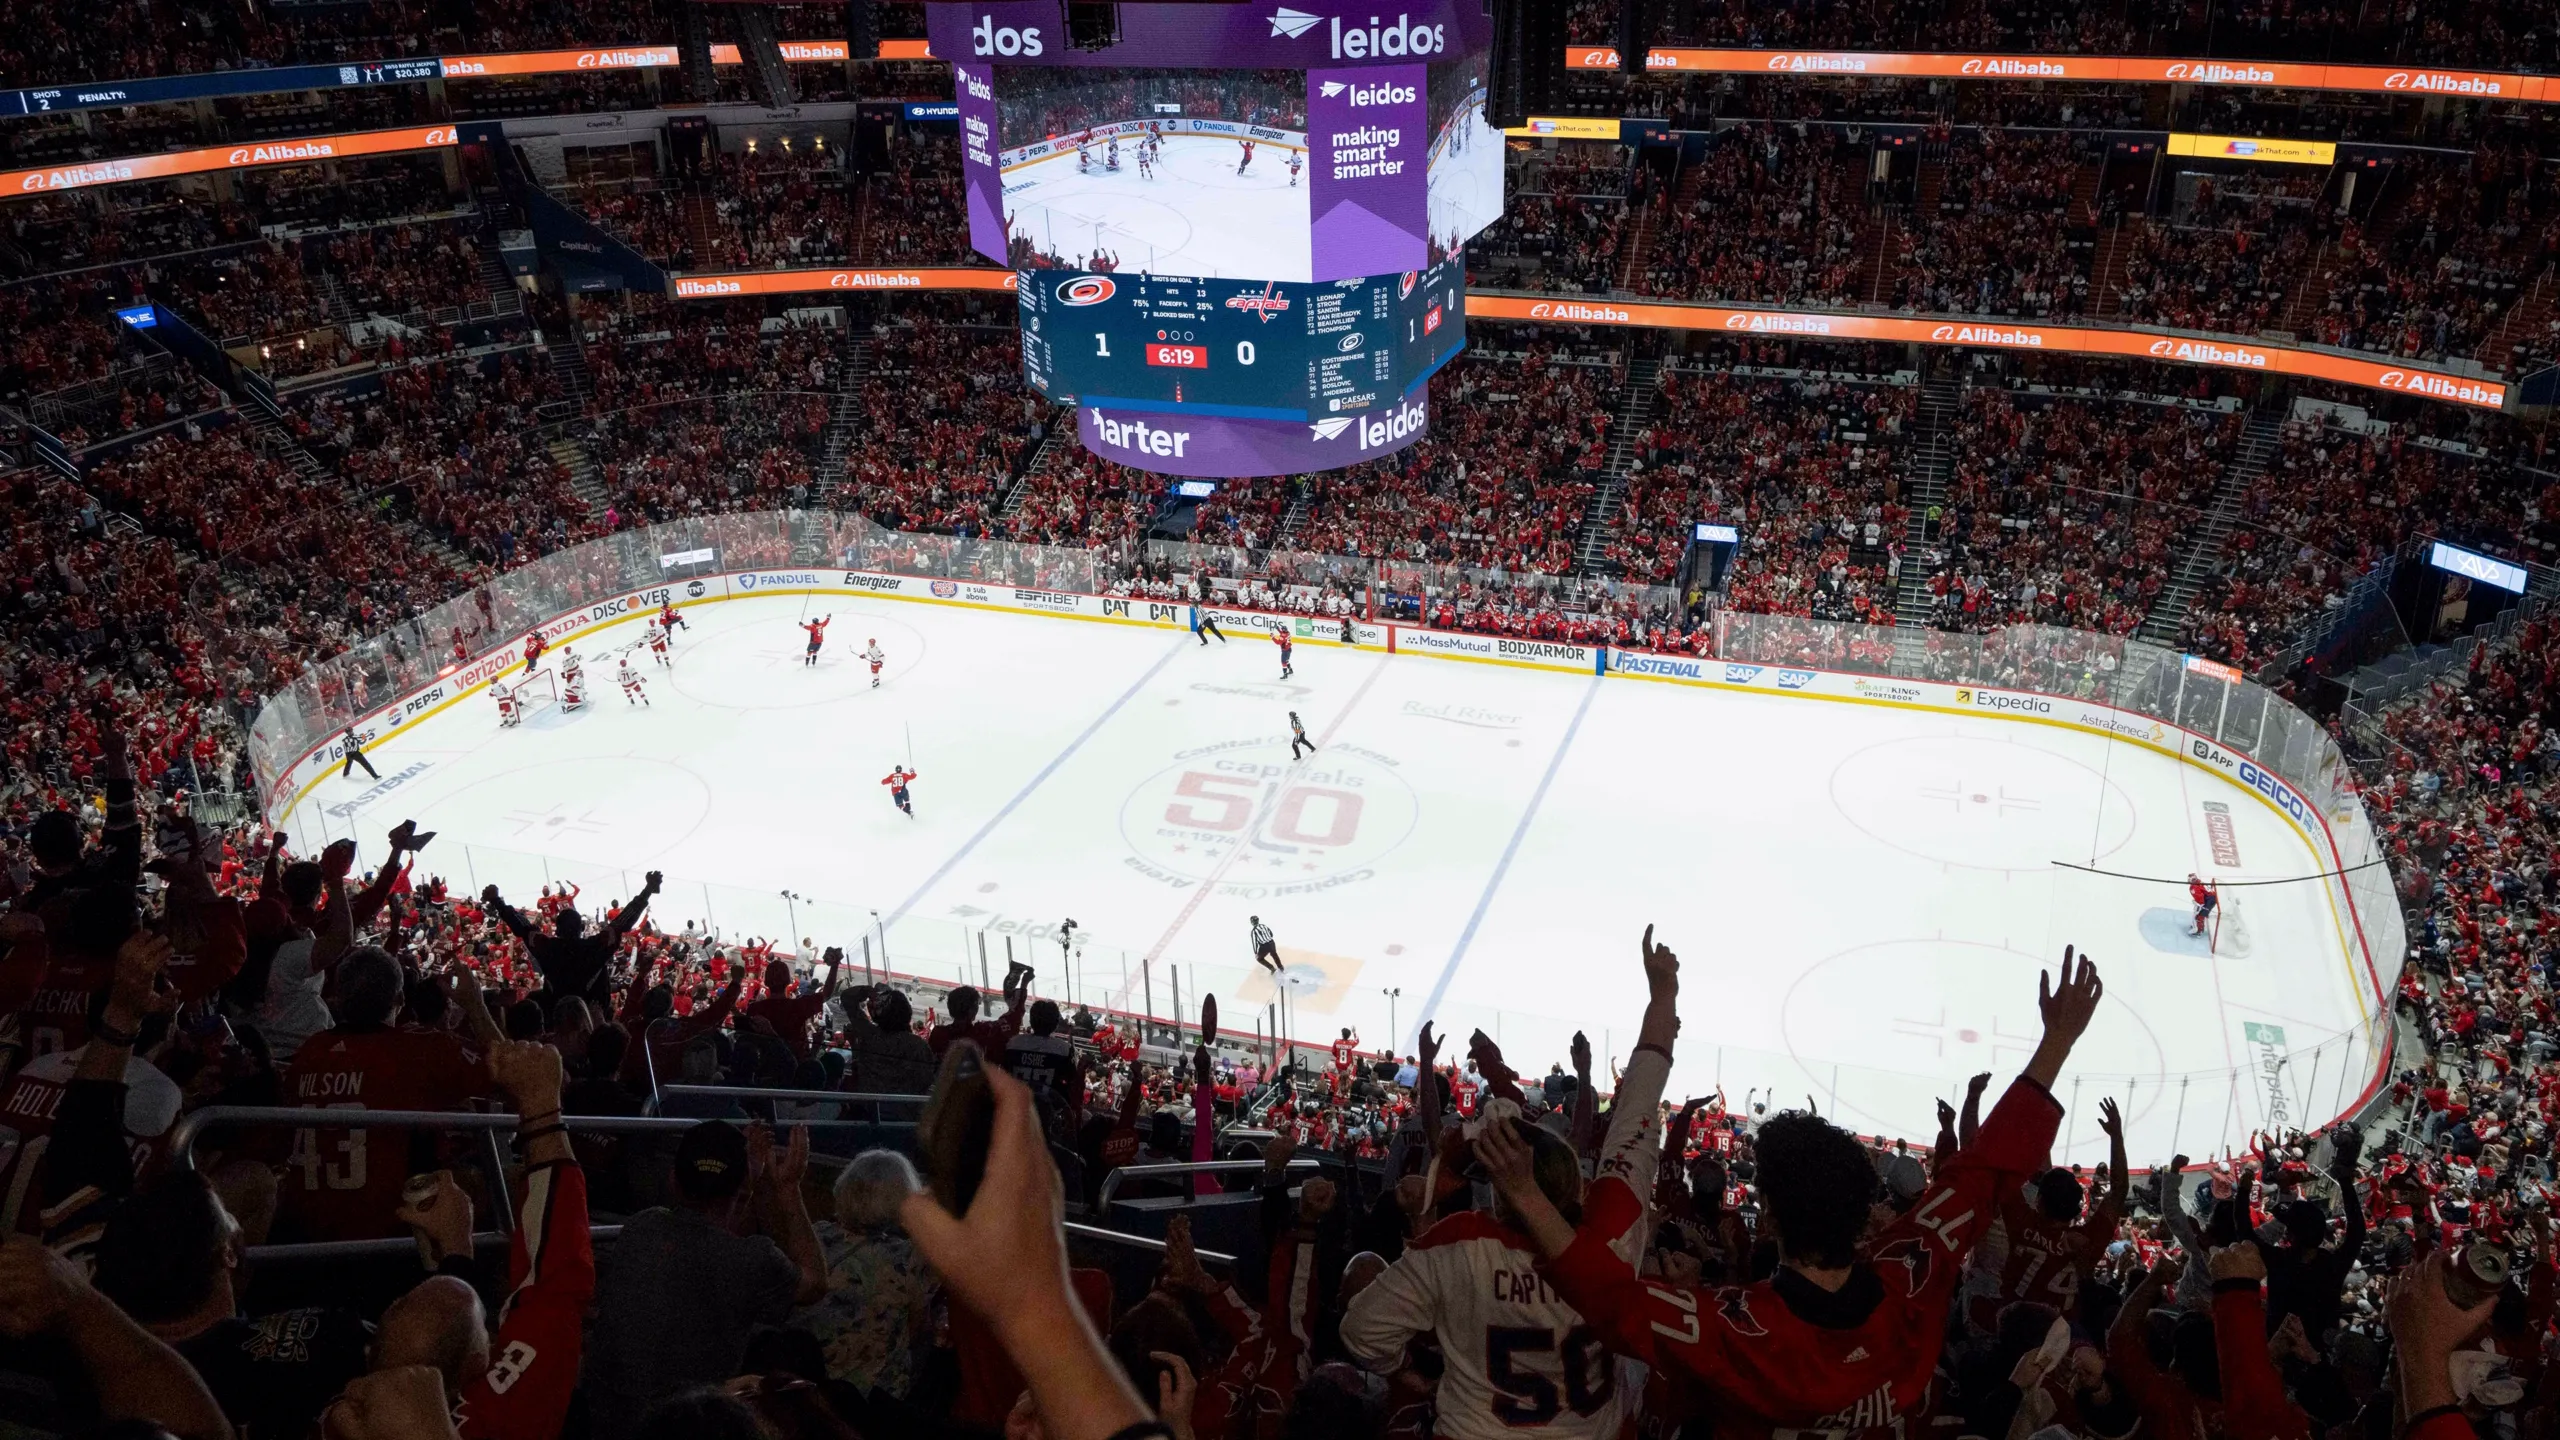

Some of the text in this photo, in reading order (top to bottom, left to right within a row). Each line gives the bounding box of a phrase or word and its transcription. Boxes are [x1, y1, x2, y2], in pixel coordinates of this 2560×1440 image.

[1331, 13, 1444, 59] leidos
[598, 51, 669, 66] Alibaba
[1791, 55, 1866, 71] Alibaba
[1984, 59, 2064, 75] Alibaba
[395, 68, 431, 79] $20,380
[2190, 64, 2274, 83] Alibaba
[967, 74, 991, 101] leidos
[2411, 74, 2500, 94] Alibaba
[33, 90, 61, 100] SHOTS
[78, 91, 126, 103] PENALTY:
[1350, 82, 1416, 107] leidos
[40, 100, 51, 110] 2
[965, 115, 989, 141] making
[1204, 122, 1236, 132] FANDUEL
[1250, 126, 1285, 140] Energizer
[967, 132, 986, 150] smart
[1332, 126, 1400, 147] making
[253, 142, 333, 161] Alibaba
[968, 147, 992, 167] smarter
[1029, 144, 1049, 157] PEPSI
[1333, 144, 1386, 163] smart
[49, 165, 133, 188] Alibaba
[1333, 160, 1404, 180] smarter
[852, 273, 920, 287] Alibaba
[1198, 277, 1205, 285] 2
[1140, 287, 1146, 295] 5
[1196, 289, 1206, 298] 13
[1225, 284, 1290, 318] capitals
[1316, 293, 1346, 302] LEONARD
[1133, 299, 1149, 308] 75%
[1196, 302, 1213, 311] 25%
[1317, 300, 1341, 308] STROME
[1317, 306, 1340, 315] SANDIN
[1317, 313, 1330, 321] VAN
[1331, 310, 1361, 319] RIEMSDYK
[1317, 317, 1355, 327] BEAUVILLIER
[1552, 305, 1628, 322] Alibaba
[1318, 324, 1352, 334] THOMPSON
[1750, 315, 1830, 333] Alibaba
[1095, 332, 1110, 357] 1
[1957, 327, 2041, 346] Alibaba
[1158, 348, 1194, 365] 6:19
[1237, 340, 1255, 365] 0
[1321, 353, 1365, 364] GOSTISBEHERE
[2175, 343, 2265, 366] Alibaba
[1322, 363, 1341, 371] BLAKE
[1322, 375, 1343, 383] SLAVIN
[1322, 380, 1352, 390] ROSLOVIC
[1323, 387, 1355, 397] ANDERSEN
[1341, 393, 1376, 405] CAESARS
[2406, 376, 2503, 405] Alibaba
[1359, 401, 1425, 450] leidos
[760, 574, 820, 586] FANDUEL
[844, 572, 902, 591] Energizer
[966, 593, 988, 602] above
[973, 586, 986, 594] sub
[1023, 602, 1075, 613] SPORTSBOOK
[1103, 598, 1130, 618] CAT
[1150, 603, 1177, 623] CAT
[541, 615, 590, 639] ONDA
[1209, 610, 1285, 631] Great Clips
[1420, 635, 1491, 652] MassMutual
[1498, 640, 1585, 661] BODYARMOR
[454, 649, 517, 690] verizon
[1615, 651, 1702, 678] FASTENAL
[2201, 660, 2230, 673] ENERGY
[621, 672, 630, 681] 71
[1727, 666, 1756, 682] SAP
[1779, 672, 1809, 688] SAP
[406, 687, 444, 715] PEPSI
[1864, 691, 1913, 701] SPORTSBOOK
[1977, 691, 2051, 713] Expedia
[1403, 700, 1523, 724] Red River
[2080, 713, 2150, 740] AstraZeneca
[1173, 736, 1401, 767] Capital Arena
[1215, 759, 1365, 787] capitals
[326, 761, 435, 818] FASTENAL
[2239, 762, 2304, 821] GEICO
[1164, 771, 1364, 847] 50
[1192, 831, 1237, 845] 1974
[2212, 815, 2237, 866] CHIPOTLE
[1124, 856, 1376, 899] Capital One Arena
[1122, 1037, 1137, 1050] 74
[1021, 1051, 1046, 1068] OSHIE
[1340, 1049, 1348, 1064] 8
[2256, 1024, 2289, 1122] enterprise
[1463, 1092, 1472, 1108] 8
[1106, 1136, 1134, 1150] STOP
[1300, 1127, 1309, 1145] 8
[1718, 1137, 1730, 1151] 19
[288, 1102, 367, 1190] 43
[1726, 1191, 1735, 1205] 8
[1914, 1187, 1975, 1252] 77
[2014, 1242, 2080, 1311] 74
[1647, 1285, 1700, 1345] 77
[486, 1339, 537, 1395] 8
[1486, 1324, 1615, 1427] 50
